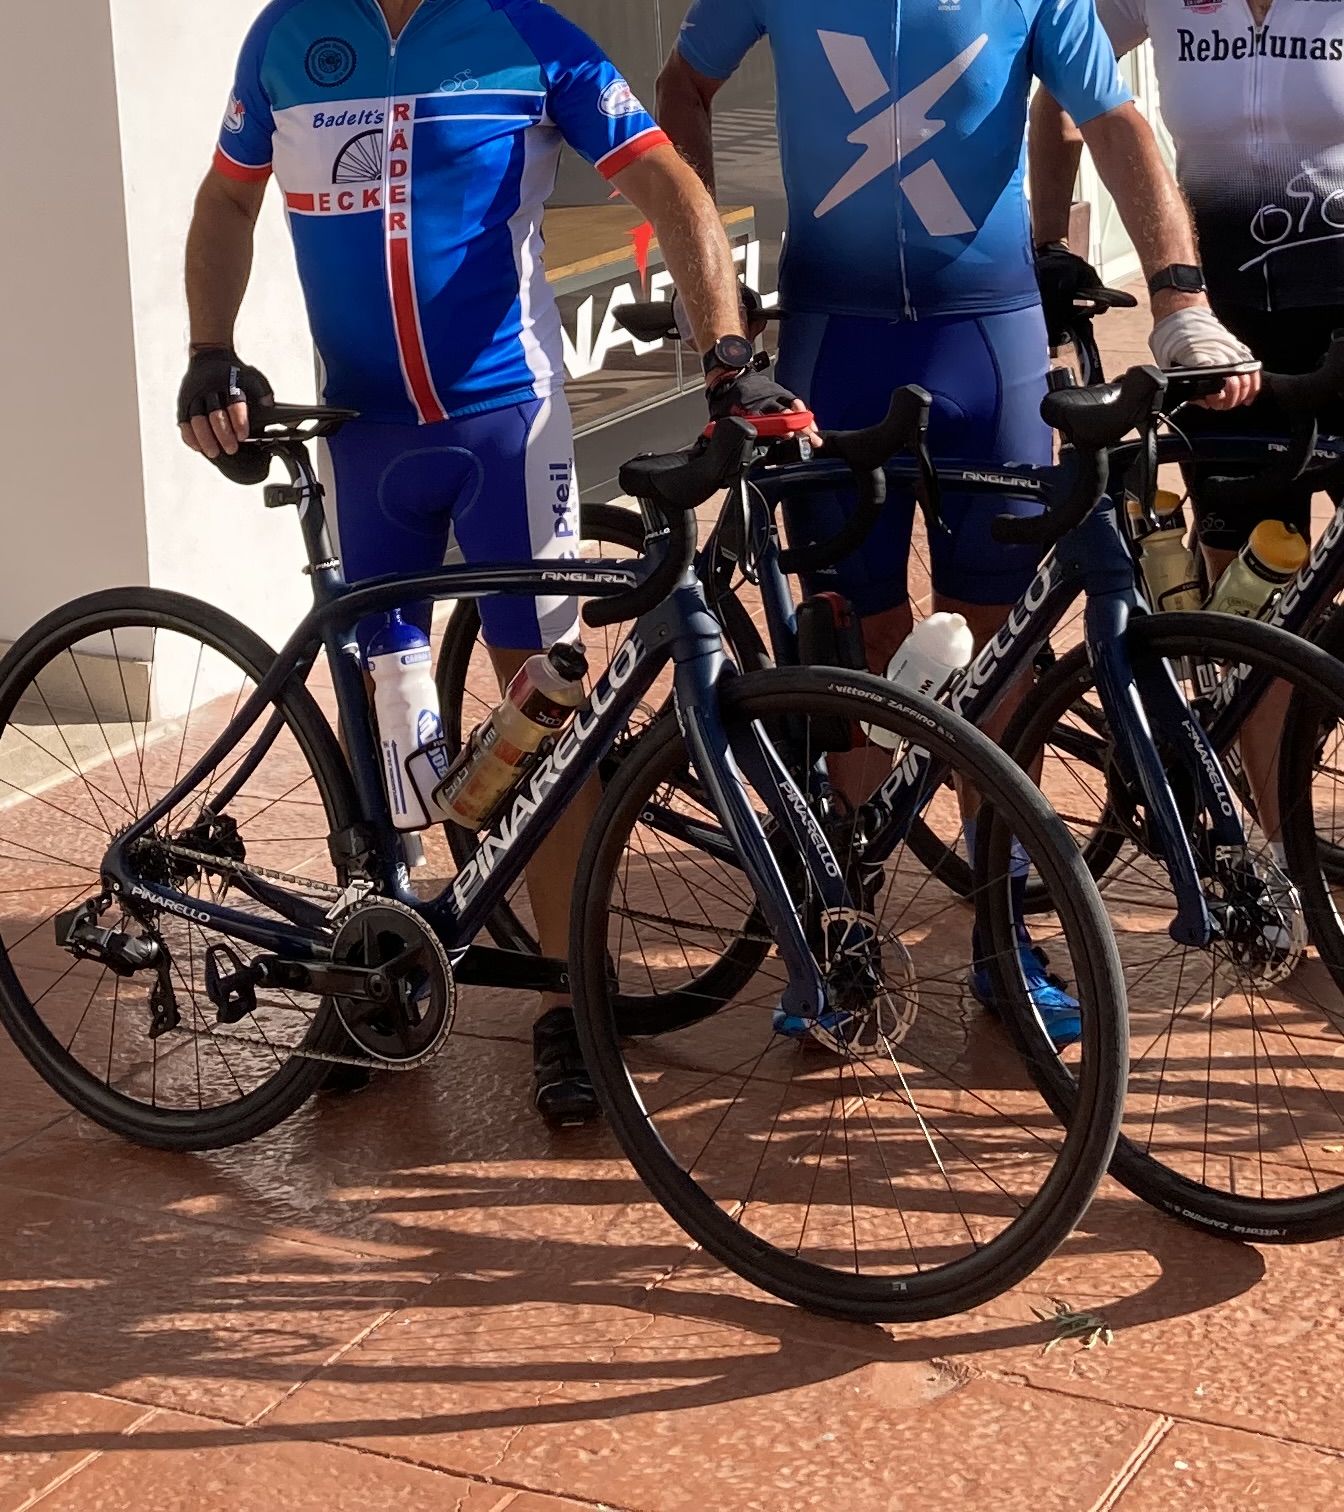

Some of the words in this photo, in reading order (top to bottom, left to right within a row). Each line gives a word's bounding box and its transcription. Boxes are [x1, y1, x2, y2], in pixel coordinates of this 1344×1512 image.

[1176, 24, 1344, 62] Rebellunas
[312, 108, 385, 129] Badelt's
[962, 471, 1041, 489] ANGLIRU
[548, 463, 574, 538] Pfeil
[541, 571, 627, 584] ANGLIRU
[880, 565, 1052, 812] PINRELLO
[886, 699, 937, 729] ZAFFIRO
[453, 637, 637, 913] PINARELLO
[778, 780, 838, 878] PINARELLO
[130, 884, 212, 924] PINARELLO
